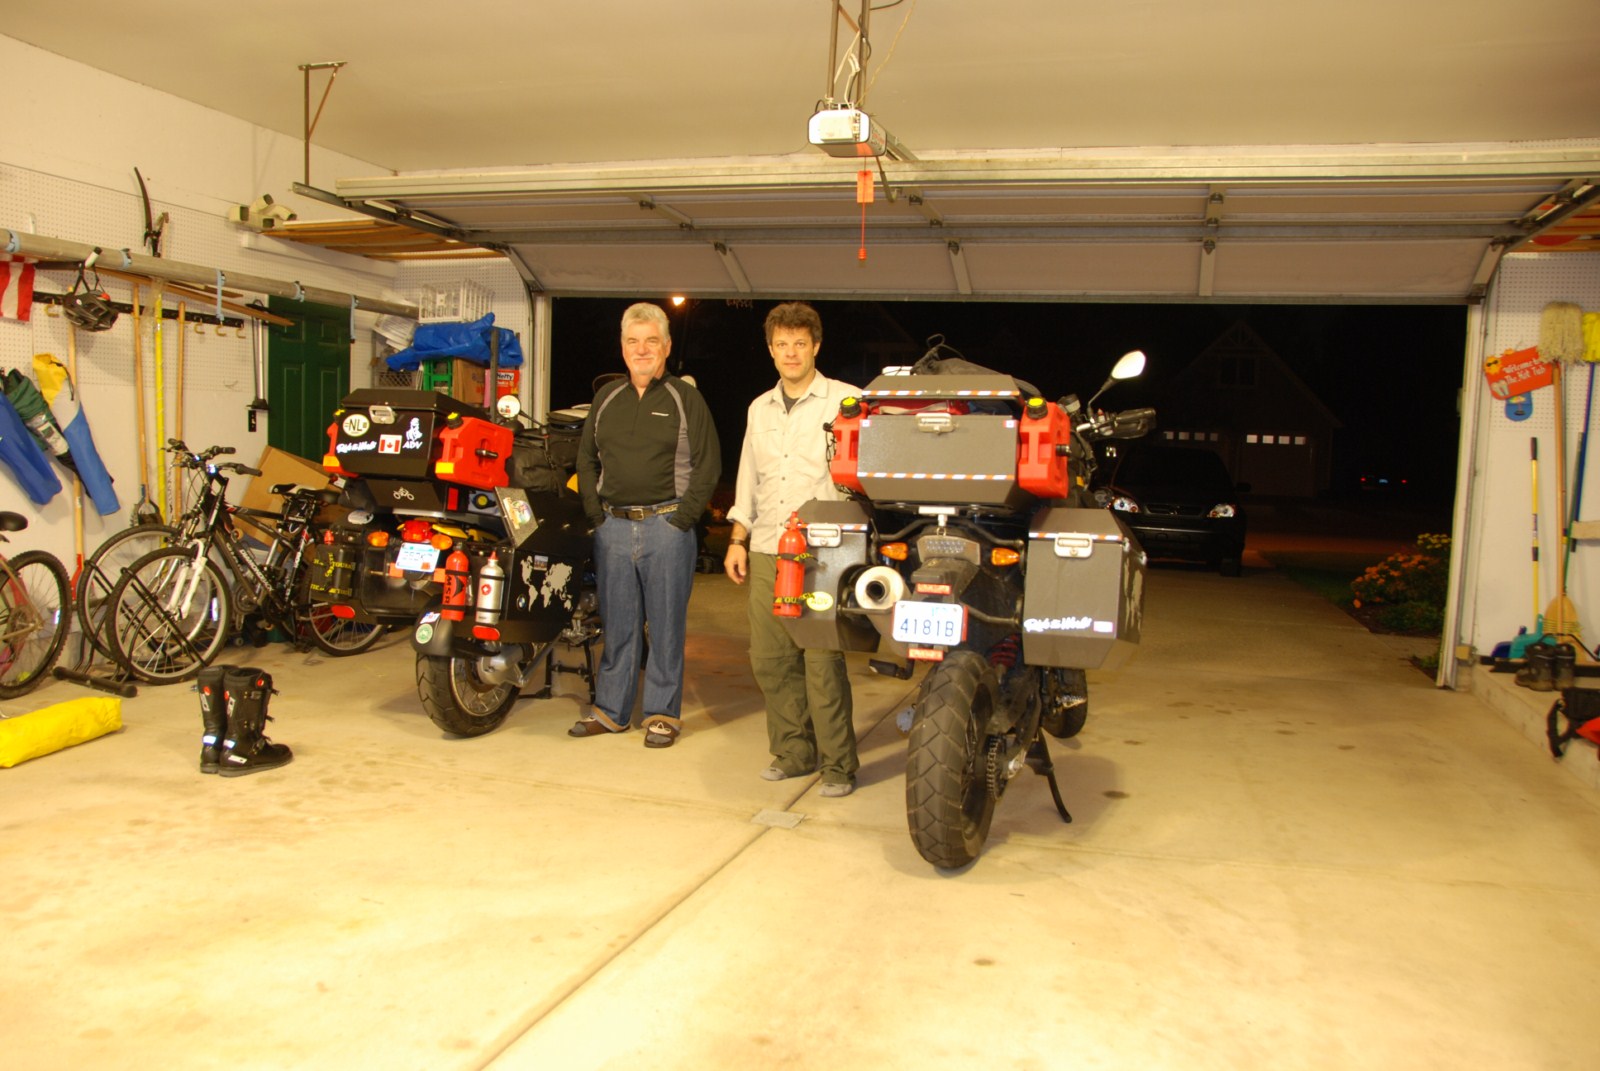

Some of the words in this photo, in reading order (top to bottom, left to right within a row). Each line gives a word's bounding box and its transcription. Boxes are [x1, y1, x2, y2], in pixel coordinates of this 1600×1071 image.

[348, 418, 363, 432] NL
[402, 441, 423, 449] ADV
[900, 617, 955, 638] 4181B
